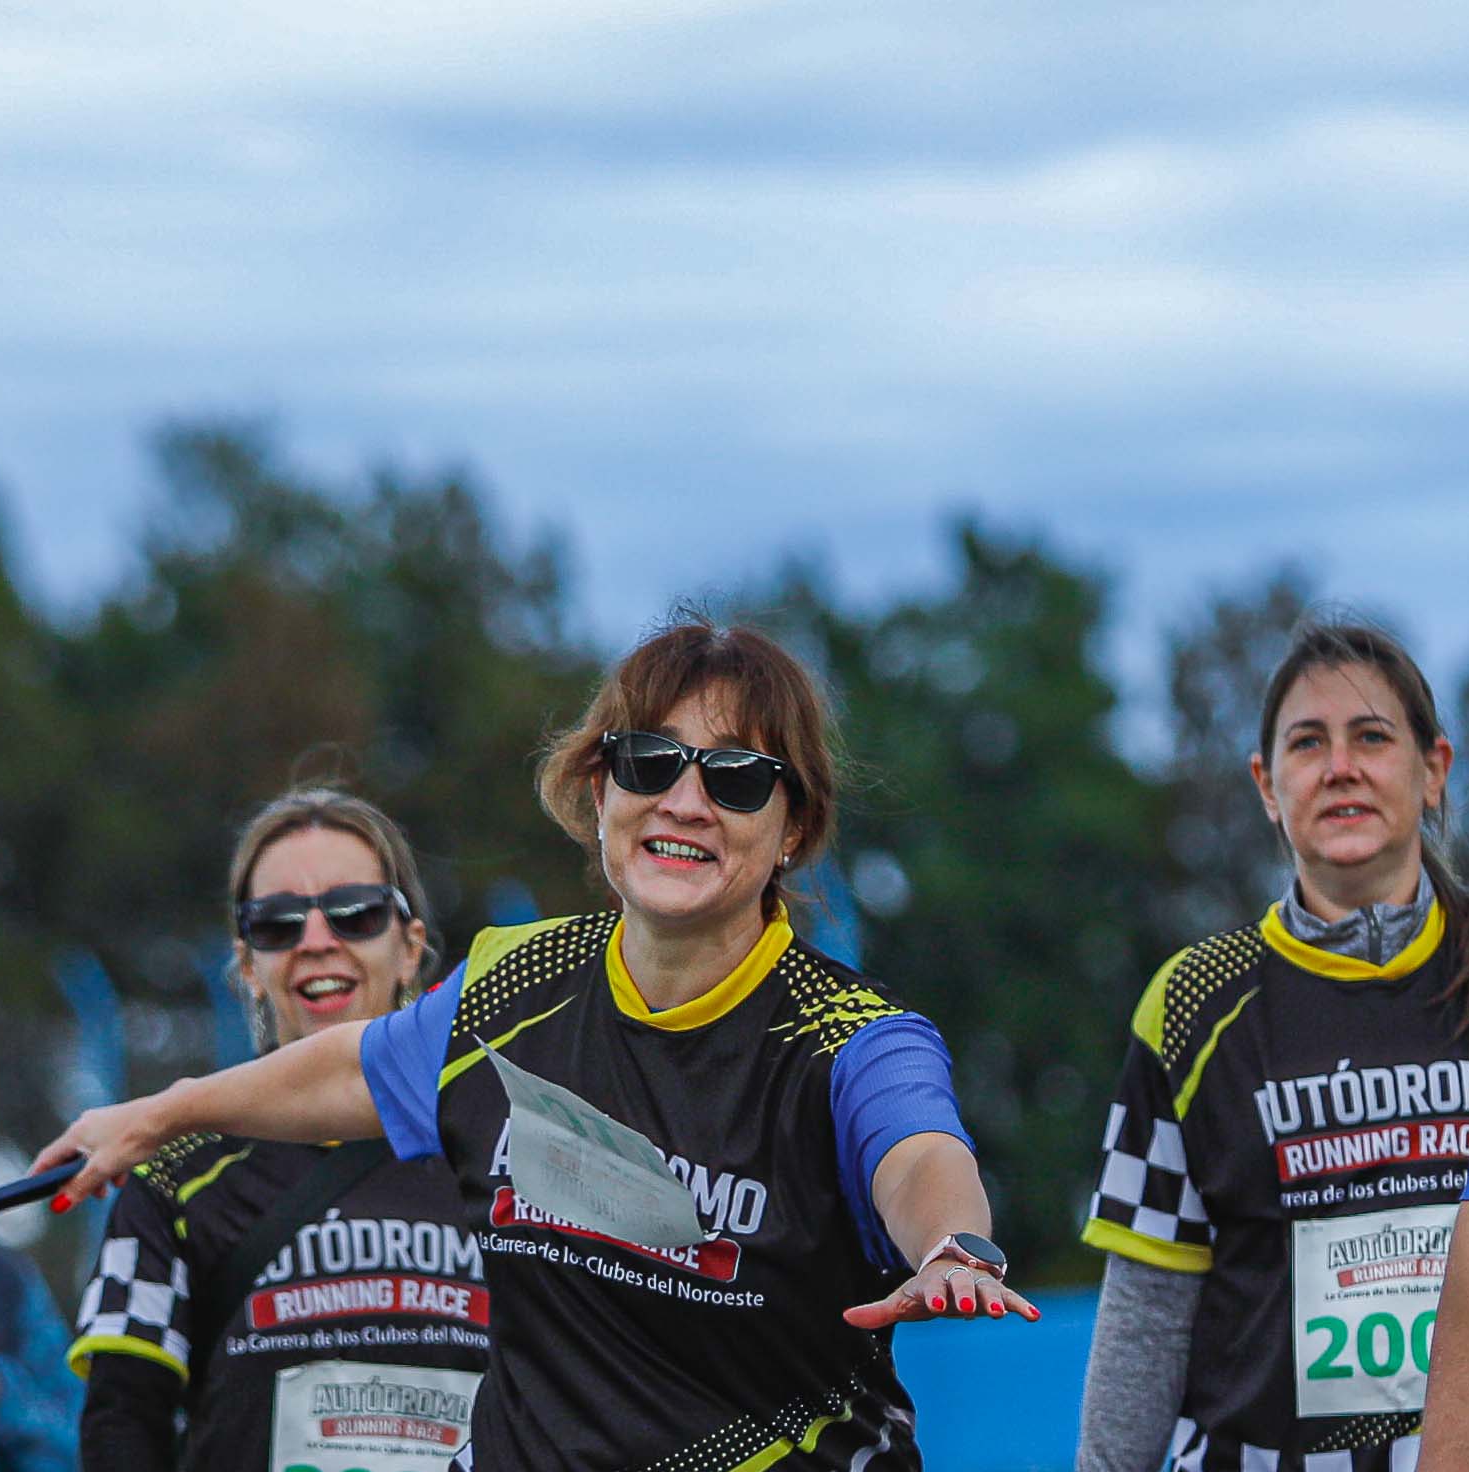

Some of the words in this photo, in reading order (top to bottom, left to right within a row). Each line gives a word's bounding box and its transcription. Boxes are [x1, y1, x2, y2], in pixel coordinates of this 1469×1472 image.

[1284, 1126, 1410, 1178] RUNNING
[1323, 1184, 1344, 1202] de
[1348, 1182, 1375, 1199] los
[1378, 1172, 1436, 1197] Clubes
[1441, 1169, 1468, 1190] del
[490, 1233, 537, 1255] Carrera
[586, 1256, 643, 1286] Clubes
[647, 1274, 672, 1295] del
[677, 1281, 764, 1306] Noroeste
[273, 1278, 394, 1322] RUNNING
[400, 1279, 471, 1319] RACE
[335, 1328, 360, 1347] los
[361, 1325, 418, 1346] Clubes
[420, 1324, 448, 1345] del
